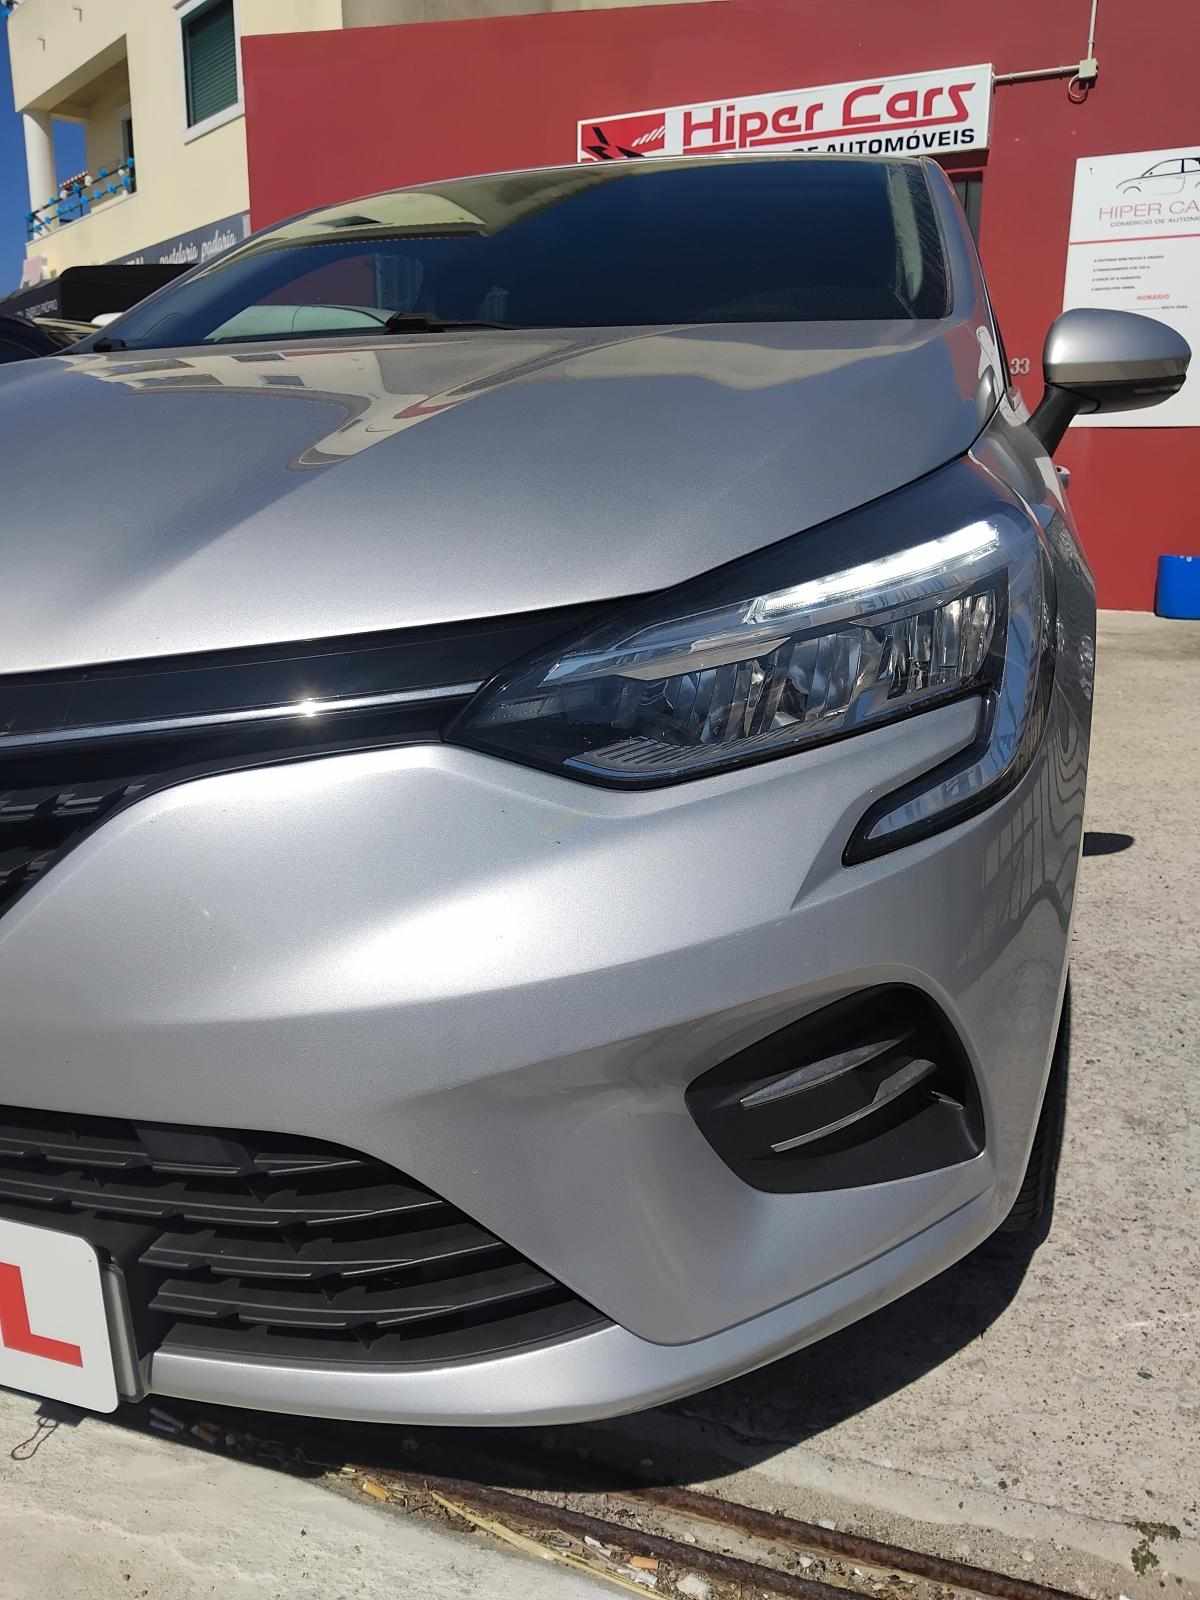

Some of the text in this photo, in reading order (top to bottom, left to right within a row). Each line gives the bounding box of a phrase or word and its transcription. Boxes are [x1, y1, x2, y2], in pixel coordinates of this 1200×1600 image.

[683, 82, 975, 149] Hiper Cars
[1098, 202, 1162, 221] HIPER
[1010, 357, 1031, 375] 33
